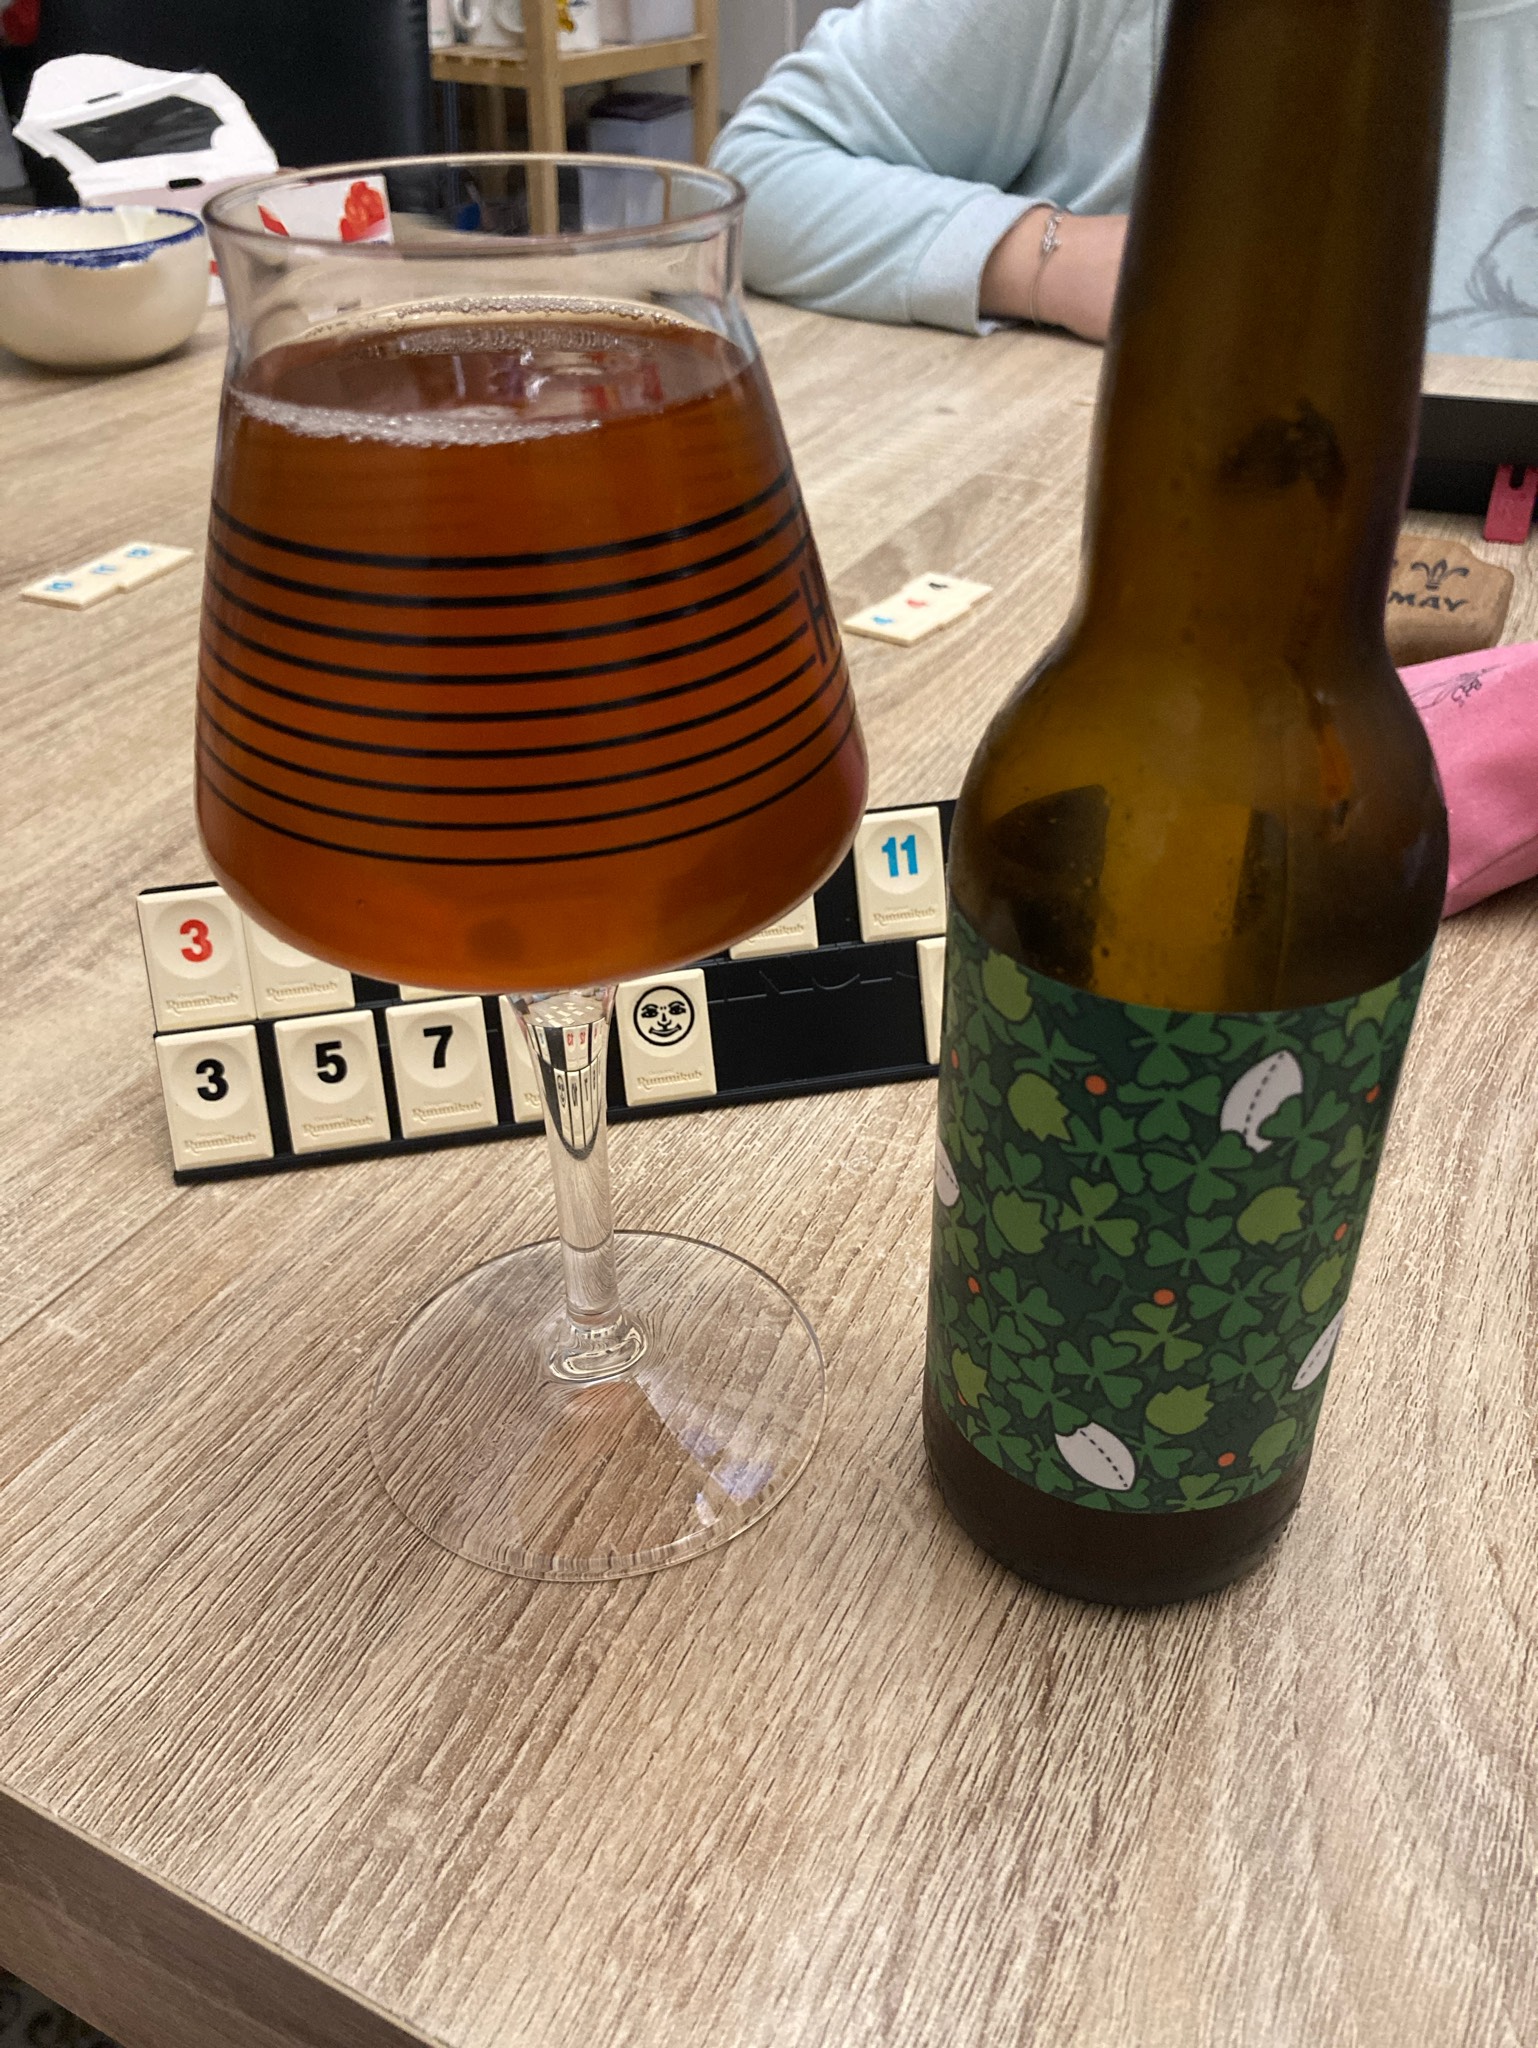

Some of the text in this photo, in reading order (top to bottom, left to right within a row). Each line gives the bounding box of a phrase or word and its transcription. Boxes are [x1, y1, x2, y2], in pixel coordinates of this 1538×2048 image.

[881, 834, 919, 878] 11
[873, 906, 936, 924] Rummikub
[179, 918, 213, 963] 3
[266, 981, 338, 1000] Rummikub
[166, 992, 239, 1013] Rummikub
[422, 1025, 453, 1069] 7
[314, 1040, 348, 1084] 5
[195, 1058, 229, 1101] 3
[637, 1069, 703, 1090] Rummikub
[412, 1100, 482, 1120] Rummikub
[303, 1116, 374, 1136] Rummikub
[184, 1131, 256, 1152] Rummikub
